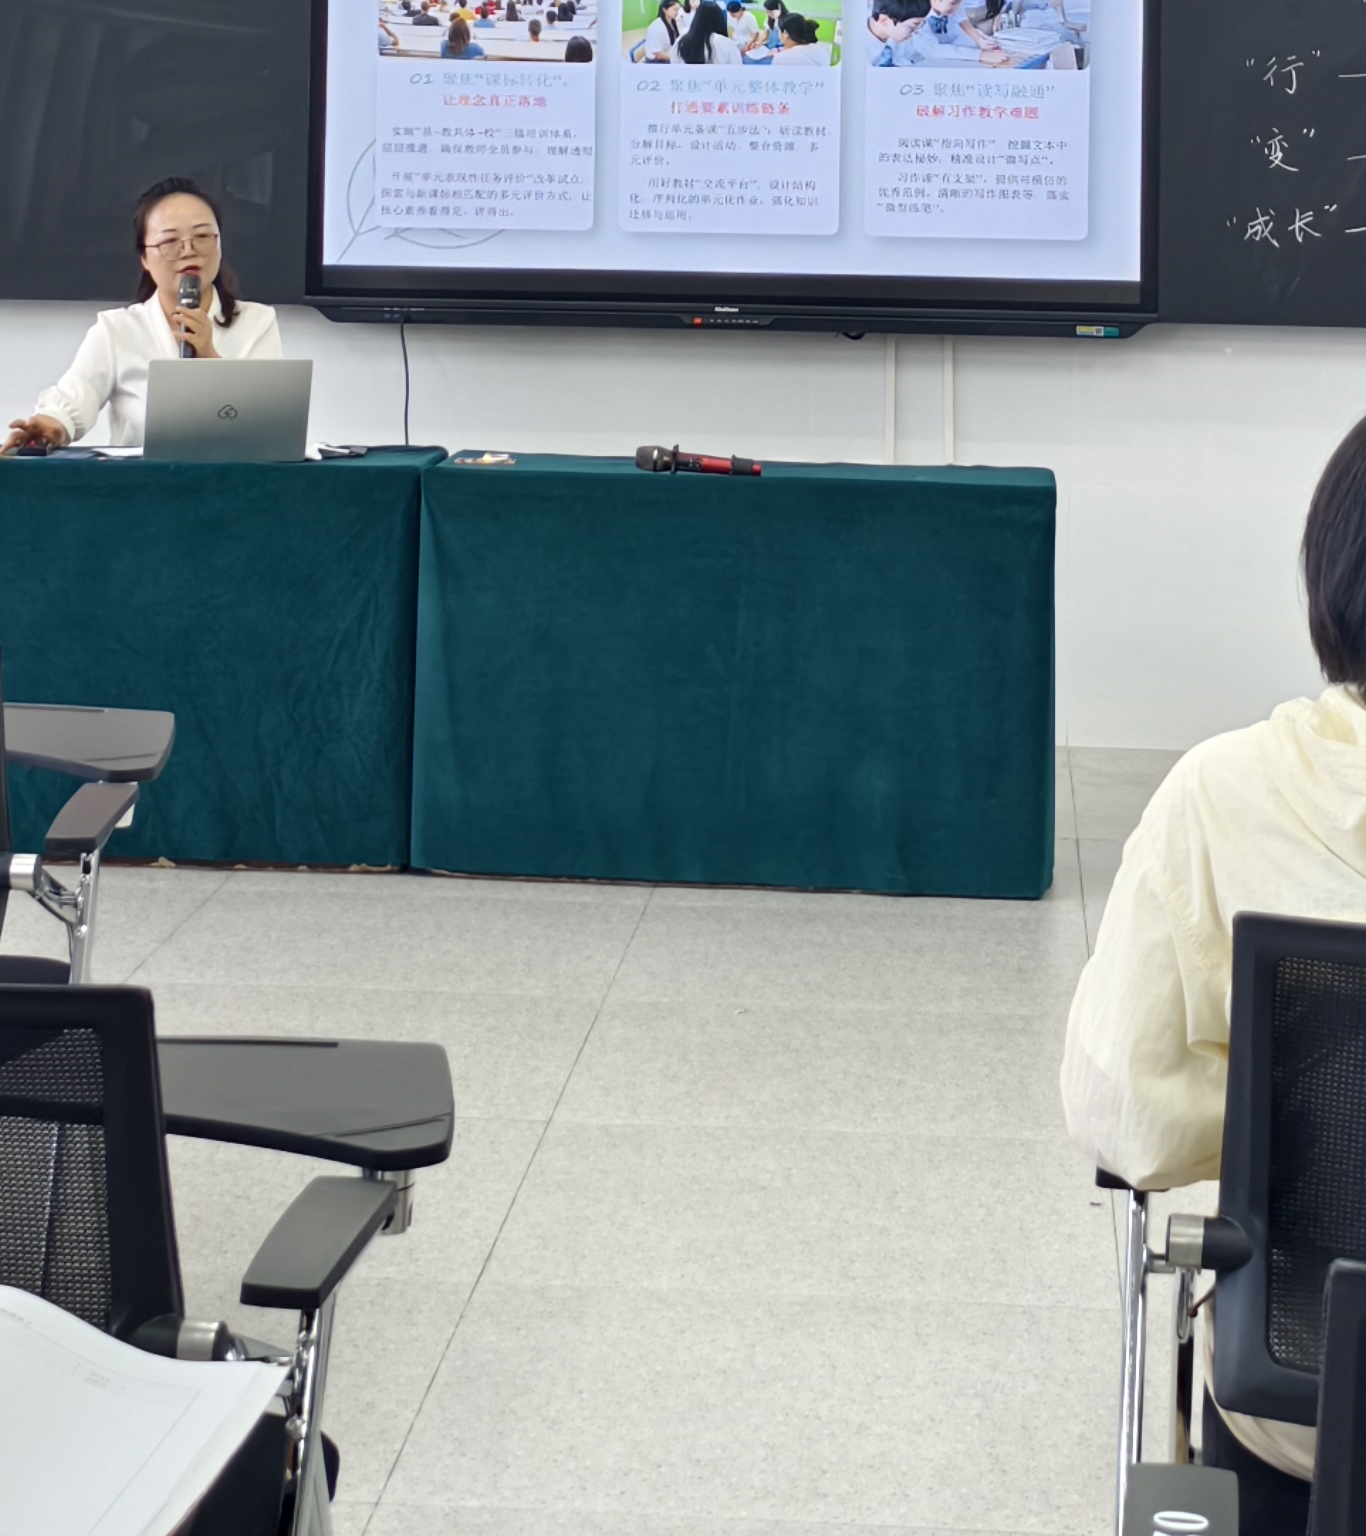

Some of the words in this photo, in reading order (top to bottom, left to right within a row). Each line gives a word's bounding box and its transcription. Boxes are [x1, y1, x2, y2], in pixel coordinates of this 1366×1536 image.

[410, 73, 433, 85] 01
[637, 81, 661, 92] 02
[900, 84, 924, 96] 03
